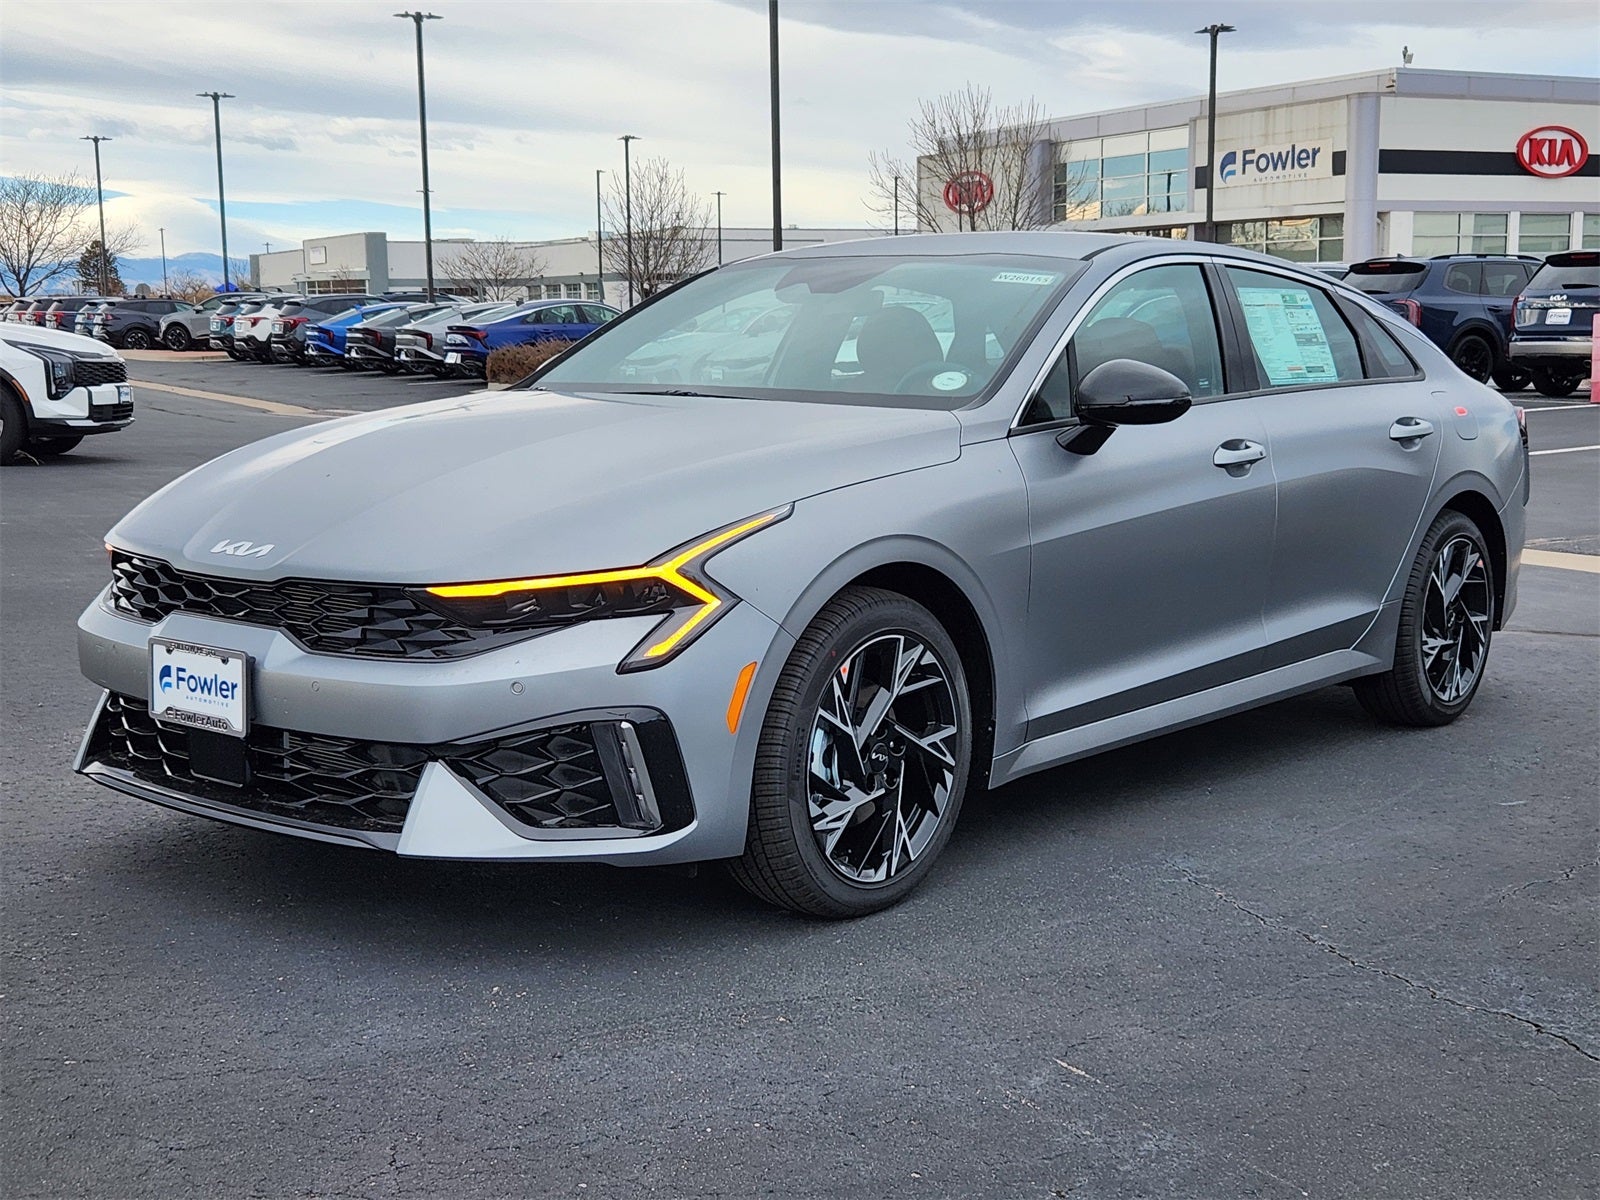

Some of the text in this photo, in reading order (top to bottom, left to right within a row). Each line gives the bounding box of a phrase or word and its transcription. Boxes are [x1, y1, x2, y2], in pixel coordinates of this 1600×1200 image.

[1241, 144, 1321, 175] Fowler
[1528, 138, 1577, 166] KIA
[1253, 173, 1307, 182] AUTOMOTIVE
[209, 539, 275, 558] KIA
[176, 666, 238, 700] Fowler
[186, 695, 229, 708] AUTOMOTIVE
[175, 708, 228, 730] FowlerAuto
